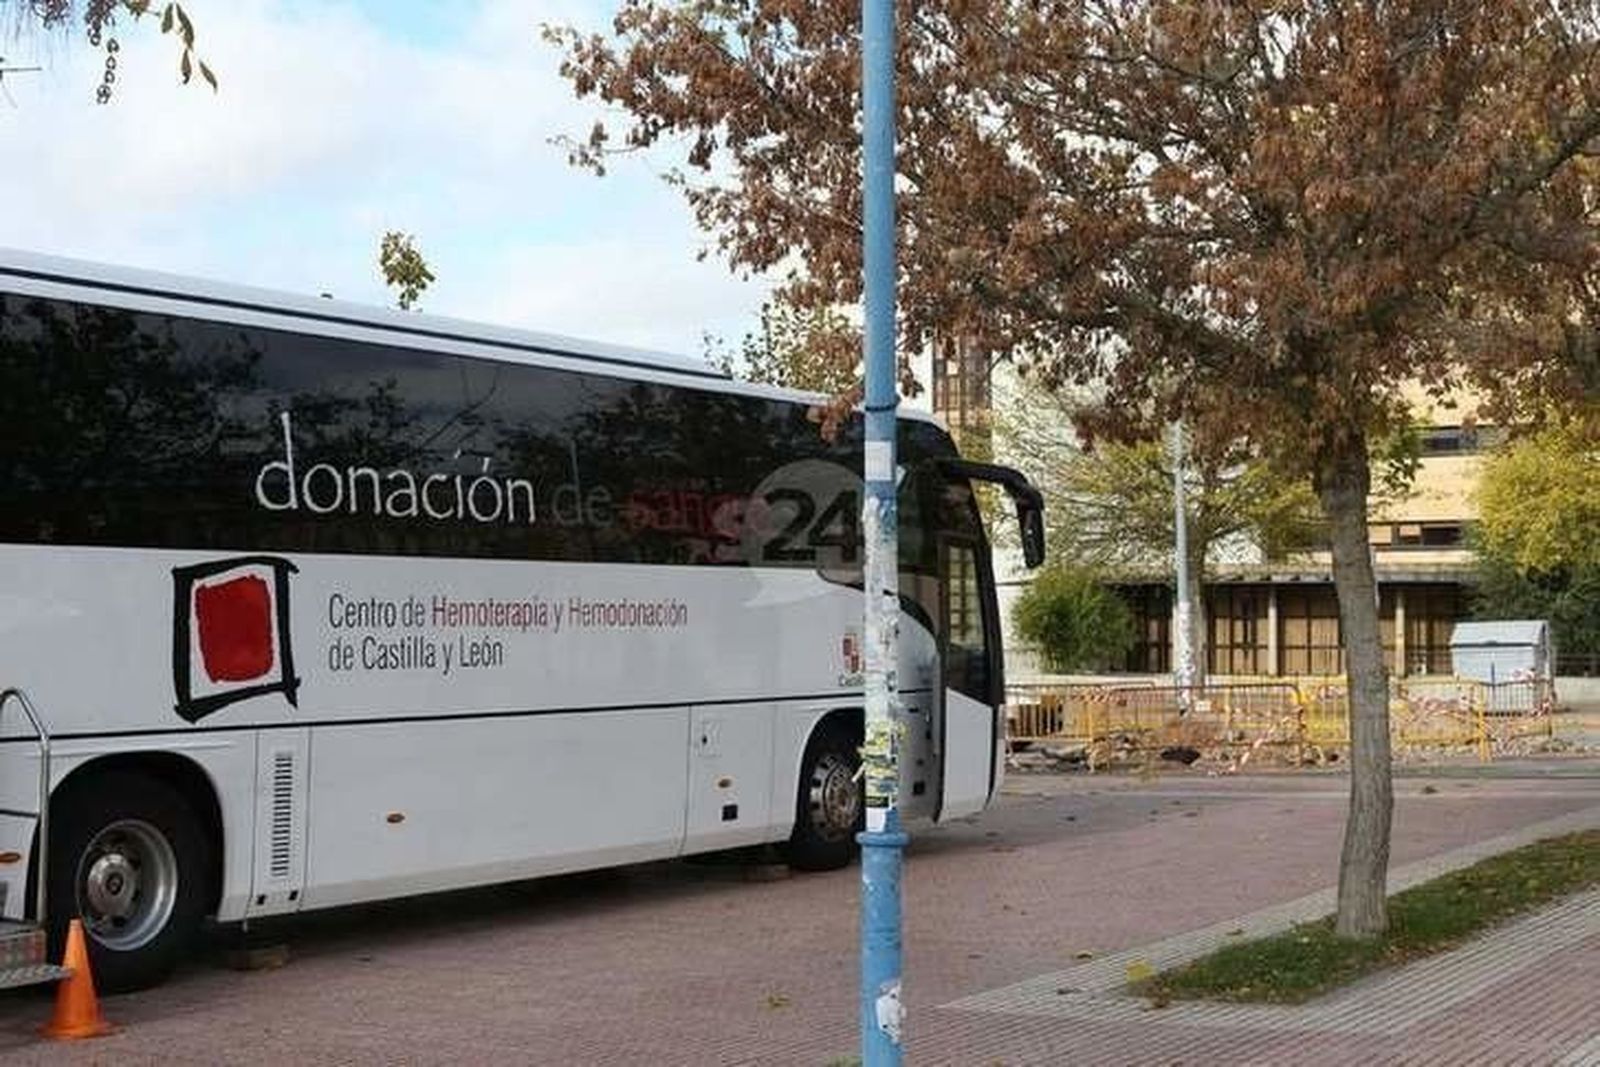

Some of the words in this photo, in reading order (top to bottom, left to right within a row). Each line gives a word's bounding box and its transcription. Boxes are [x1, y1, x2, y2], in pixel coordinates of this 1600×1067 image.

[255, 411, 535, 523] donación
[552, 441, 612, 526] de
[328, 593, 397, 627] Centro
[401, 596, 426, 626] de
[431, 595, 548, 632] Hemoterapia
[553, 602, 565, 635] y
[568, 597, 688, 629] Hemodonación
[328, 636, 354, 672] de
[361, 635, 436, 671] Castilla
[442, 643, 453, 677] y
[458, 635, 504, 668] León
